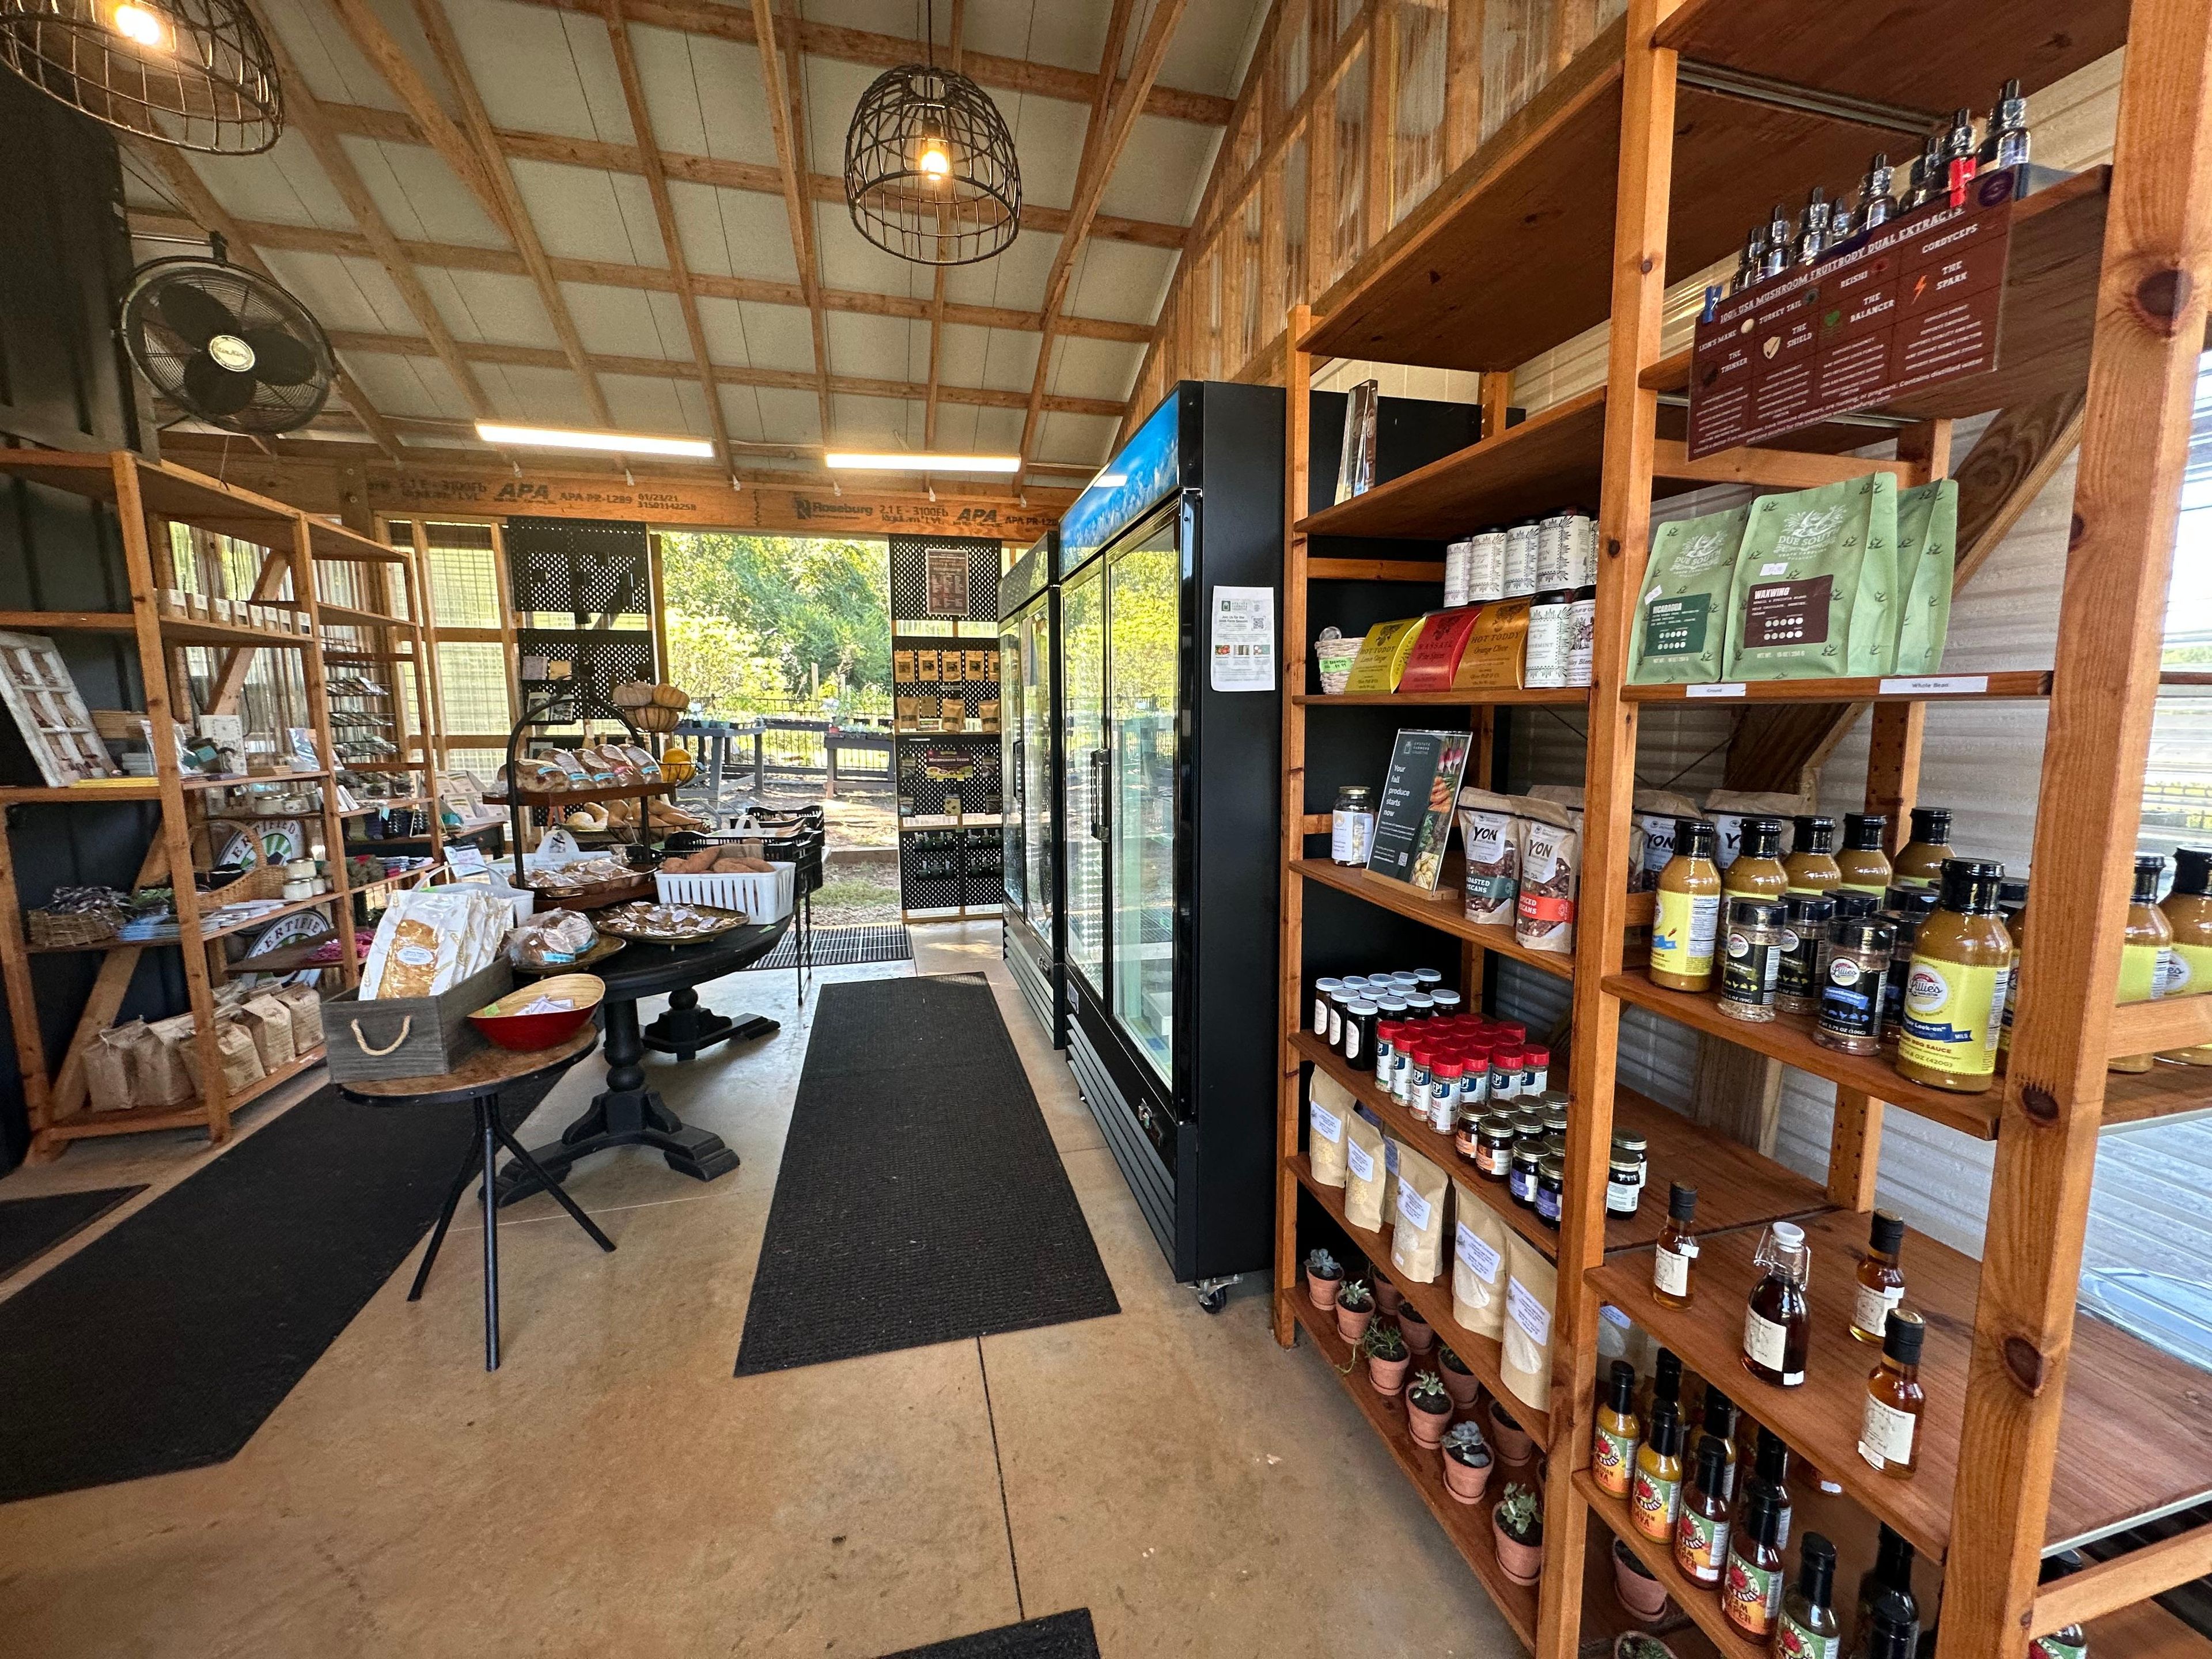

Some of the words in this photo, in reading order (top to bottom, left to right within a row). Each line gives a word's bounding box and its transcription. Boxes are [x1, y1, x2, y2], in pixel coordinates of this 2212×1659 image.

[1922, 224, 1978, 253] CORDYCEPS
[1738, 301, 1753, 315] USA
[1756, 274, 1808, 305] MUSHROOM
[1810, 248, 1865, 280] FRUITBODY
[1868, 234, 1896, 253] DUAL
[1941, 261, 1963, 275] THE
[1840, 271, 1868, 288] REISHI
[1936, 272, 1968, 290] SPARK
[1863, 292, 1881, 305] THE
[1759, 308, 1785, 324] TURKEY
[1786, 300, 1802, 312] TAIL
[1850, 300, 1895, 323] BALANCER
[1792, 323, 1807, 334] THE
[1787, 332, 1812, 348] SHIELD
[1729, 350, 1741, 360] THE
[1721, 358, 1747, 373] THINKER
[497, 483, 550, 499] APA
[559, 493, 584, 502] APA
[813, 501, 873, 516] Roseburg
[956, 508, 997, 522] APA
[1005, 516, 1024, 525] APA
[1778, 536, 1801, 546] DUE
[1801, 527, 1841, 546] SOUTH
[1675, 556, 1691, 565] DUE
[1692, 548, 1721, 565] SOUTH
[1754, 586, 1790, 600] WAXWING
[1471, 635, 1489, 643] HOT
[1491, 632, 1519, 642] TODDY
[1394, 764, 1406, 772] Your
[1391, 775, 1400, 783] fall
[1388, 787, 1410, 797] produce
[1386, 798, 1401, 806] starts
[1474, 826, 1498, 842] YON
[1528, 839, 1553, 858] YON
[1926, 1044, 1952, 1054] SAUCE
[1926, 1056, 1953, 1067] (420G)
